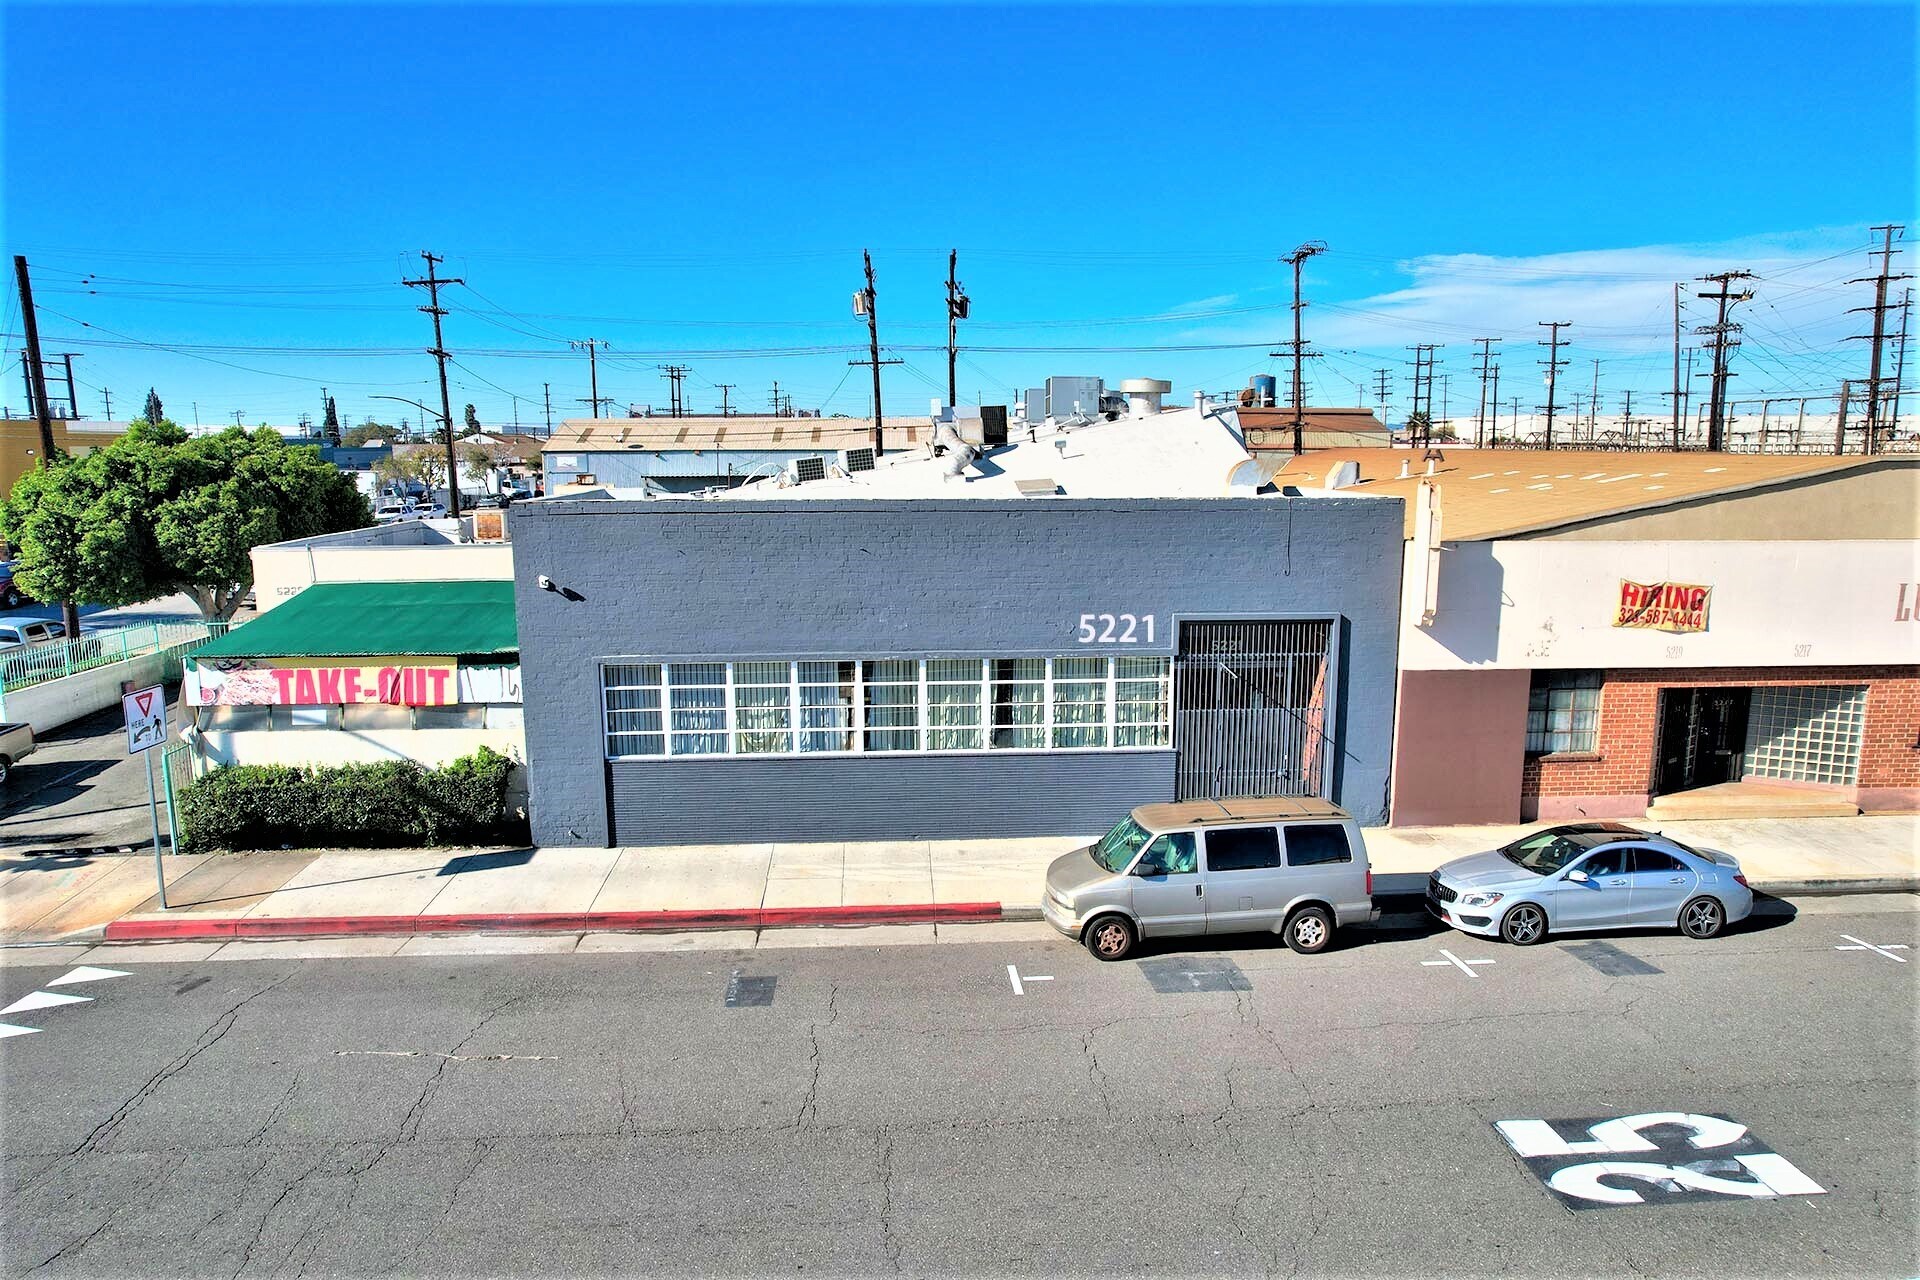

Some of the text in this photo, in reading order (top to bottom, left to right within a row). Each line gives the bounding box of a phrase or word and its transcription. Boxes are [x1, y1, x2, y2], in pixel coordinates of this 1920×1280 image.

[1621, 583, 1706, 612] HIRING
[1078, 613, 1155, 643] 5221
[1618, 607, 1702, 628] 323-587-4444
[271, 665, 450, 706] TAKE-OUT
[1493, 1111, 1829, 1204] 25
